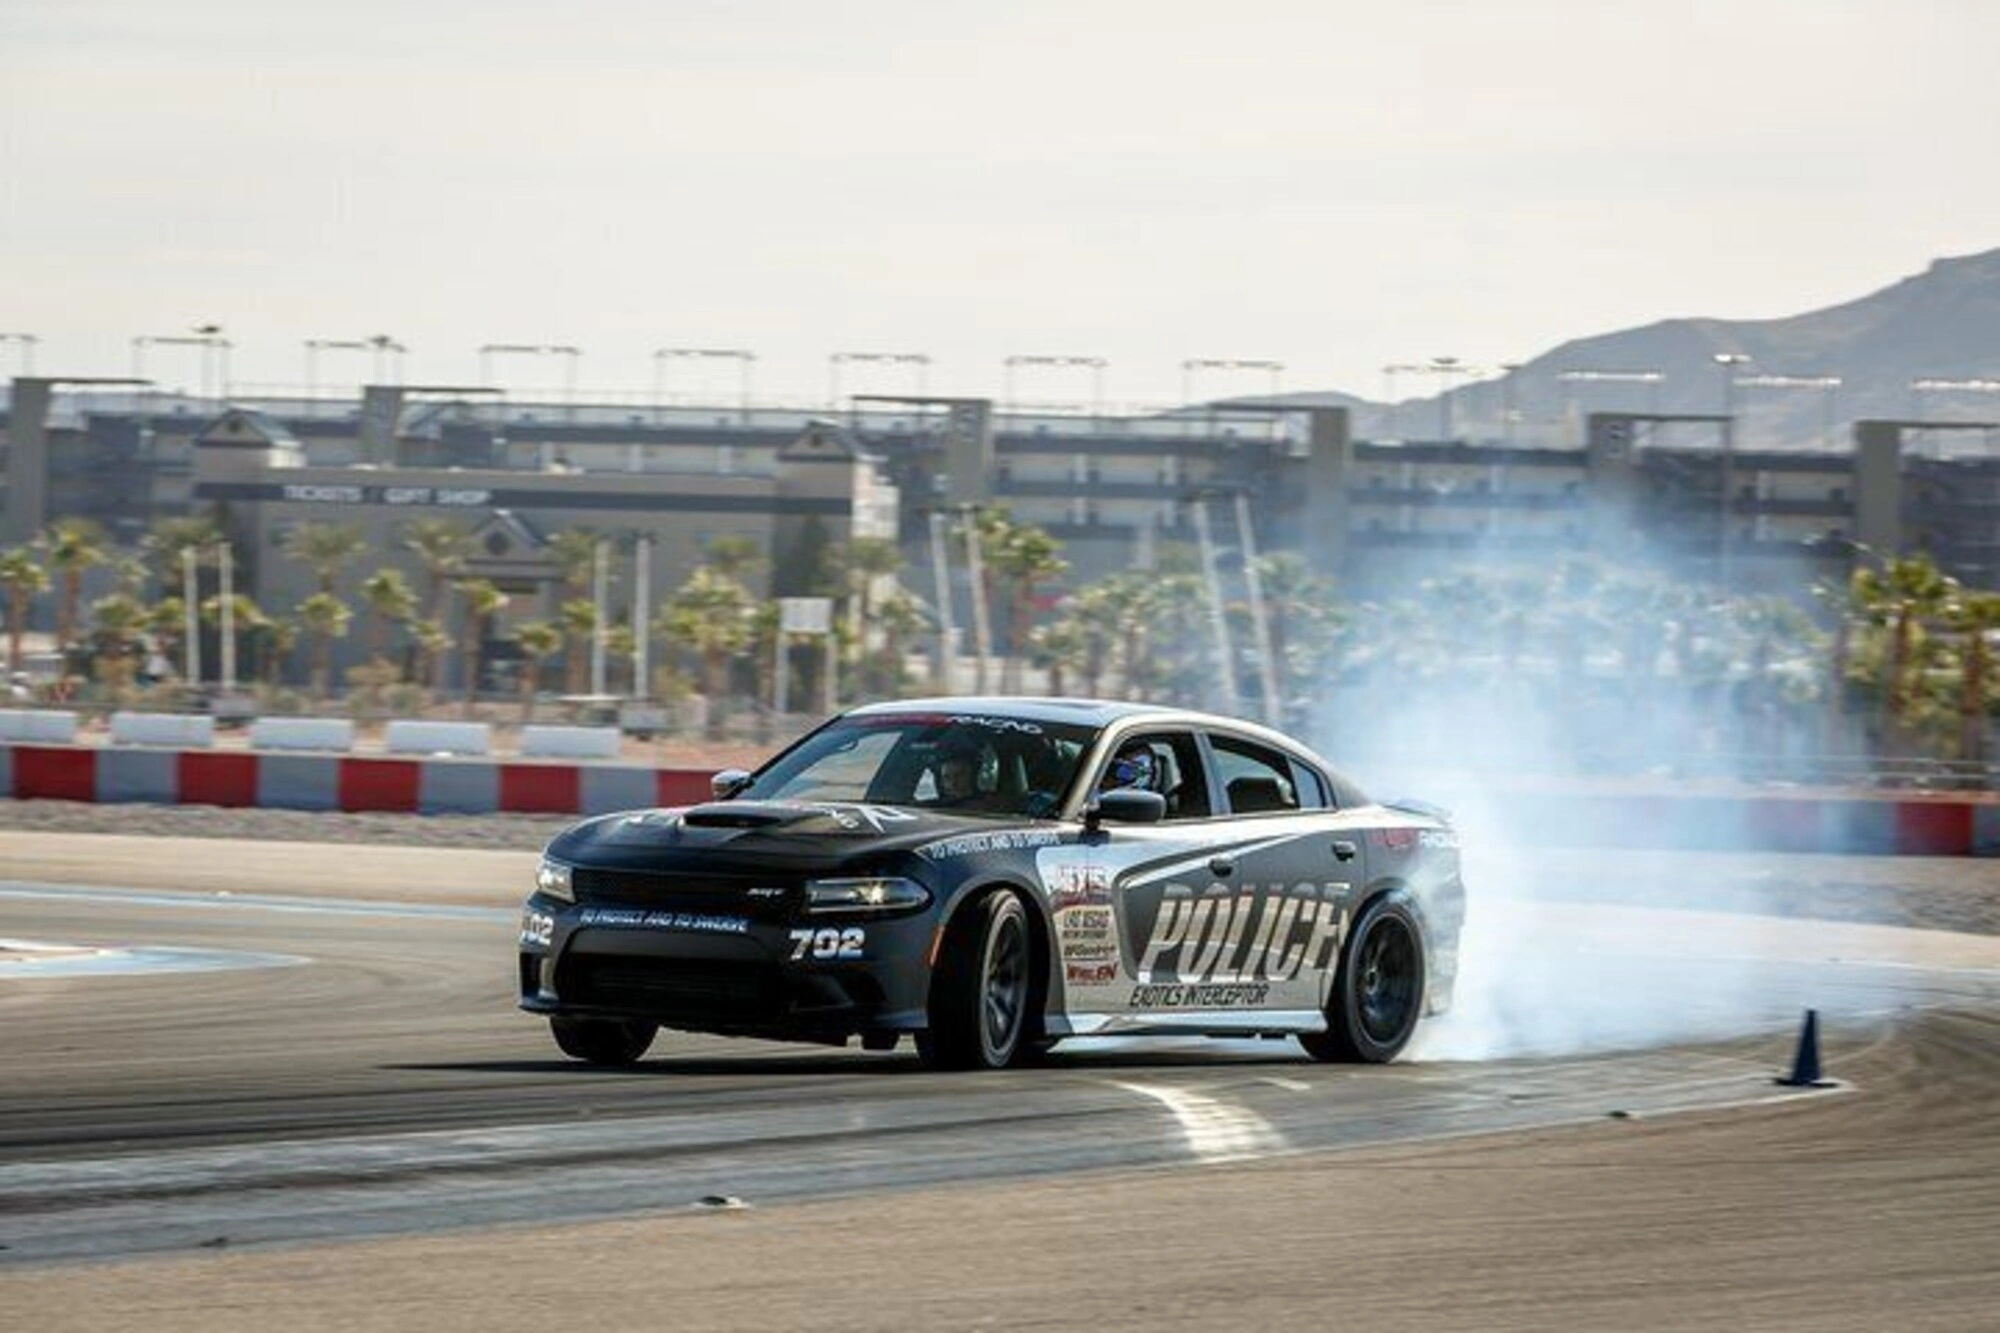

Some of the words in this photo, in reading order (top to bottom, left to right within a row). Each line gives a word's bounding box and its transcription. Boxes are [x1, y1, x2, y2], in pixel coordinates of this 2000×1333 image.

[788, 926, 866, 961] 702
[1129, 984, 1184, 1008] EXOTICS
[1182, 984, 1270, 1006] INTERCEPTOR
